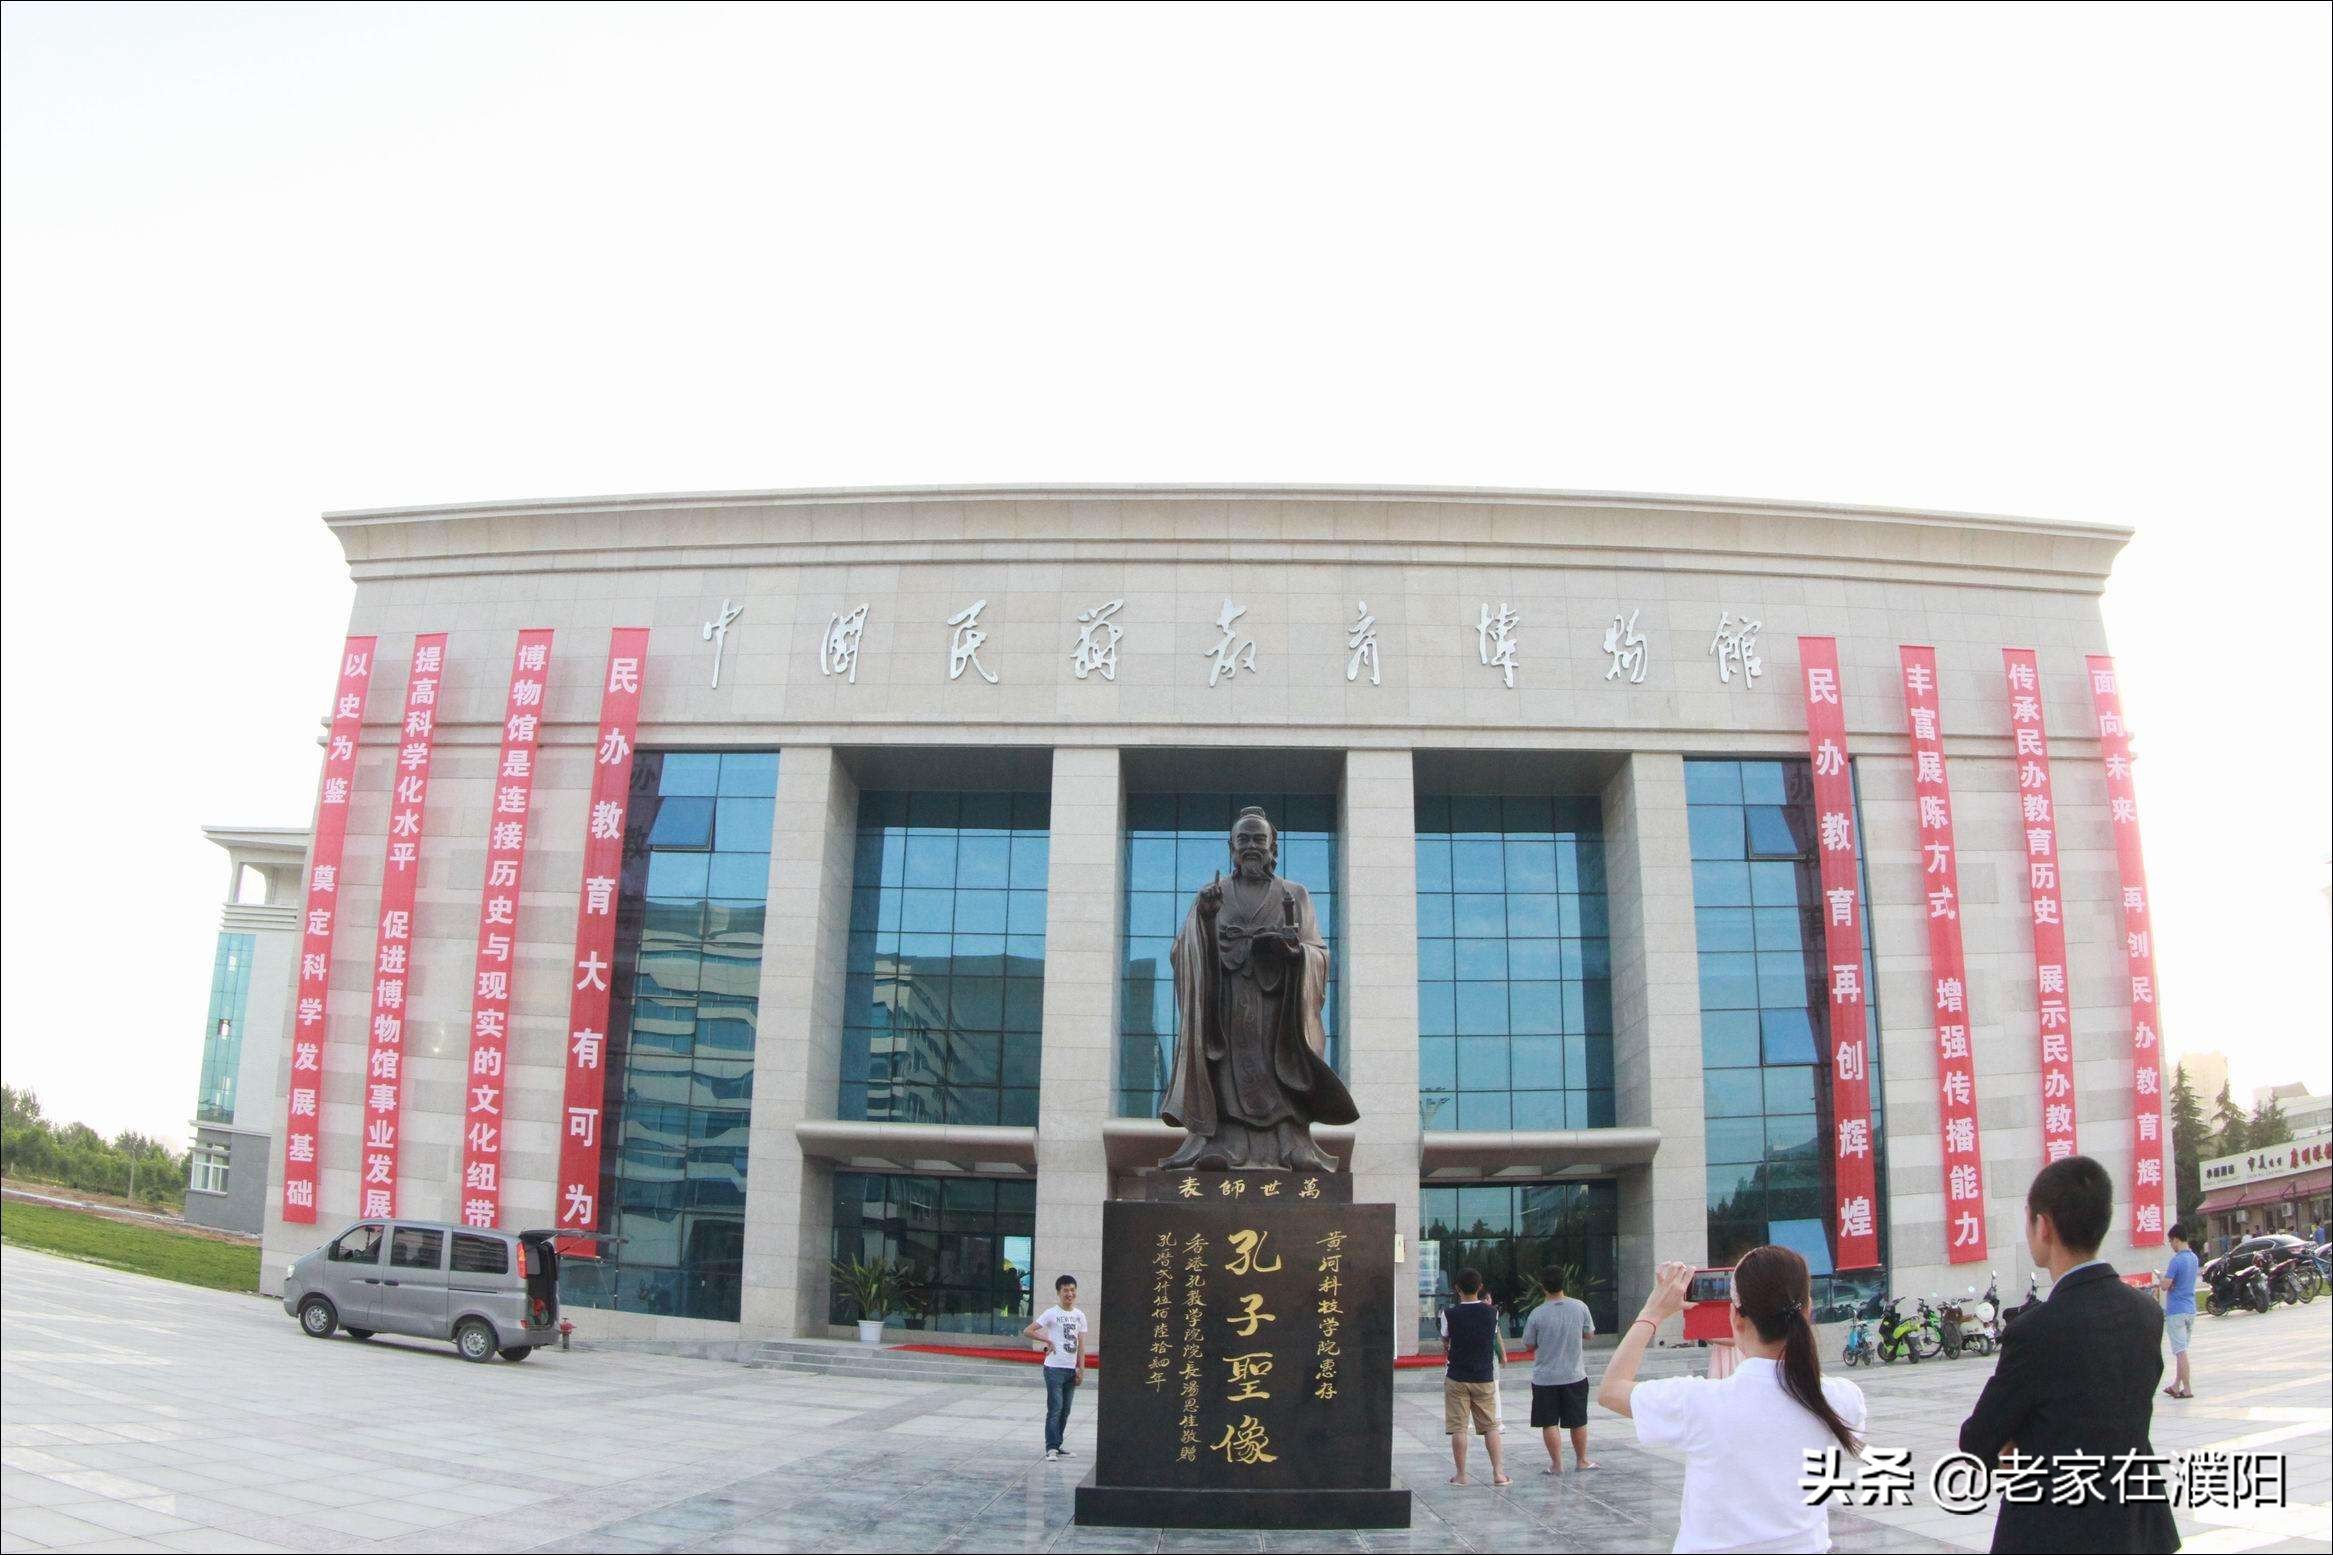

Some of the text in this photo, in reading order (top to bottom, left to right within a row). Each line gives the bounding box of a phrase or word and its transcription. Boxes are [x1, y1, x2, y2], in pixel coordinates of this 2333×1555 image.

[287, 651, 367, 1208] 以史为鉴 奠定科学发展基础
[364, 646, 441, 1218] 提高科学化水平 促进博物馆事业发展
[465, 644, 548, 1228] 博物馆是连接历史与现实的文化纽带
[563, 657, 639, 1224] 民办教育大有可为
[1808, 668, 1873, 1238] 民办教育再创辉煌
[1907, 663, 1980, 1247] 丰富展陈方式 增强传播能力
[2009, 662, 2074, 1162] 传承民办教育历史 展示民办教育
[2092, 668, 2136, 824] 面向未来
[2123, 886, 2162, 1232] 再创民办教育辉煌
[1210, 1229, 1282, 1464] 孔子聖像
